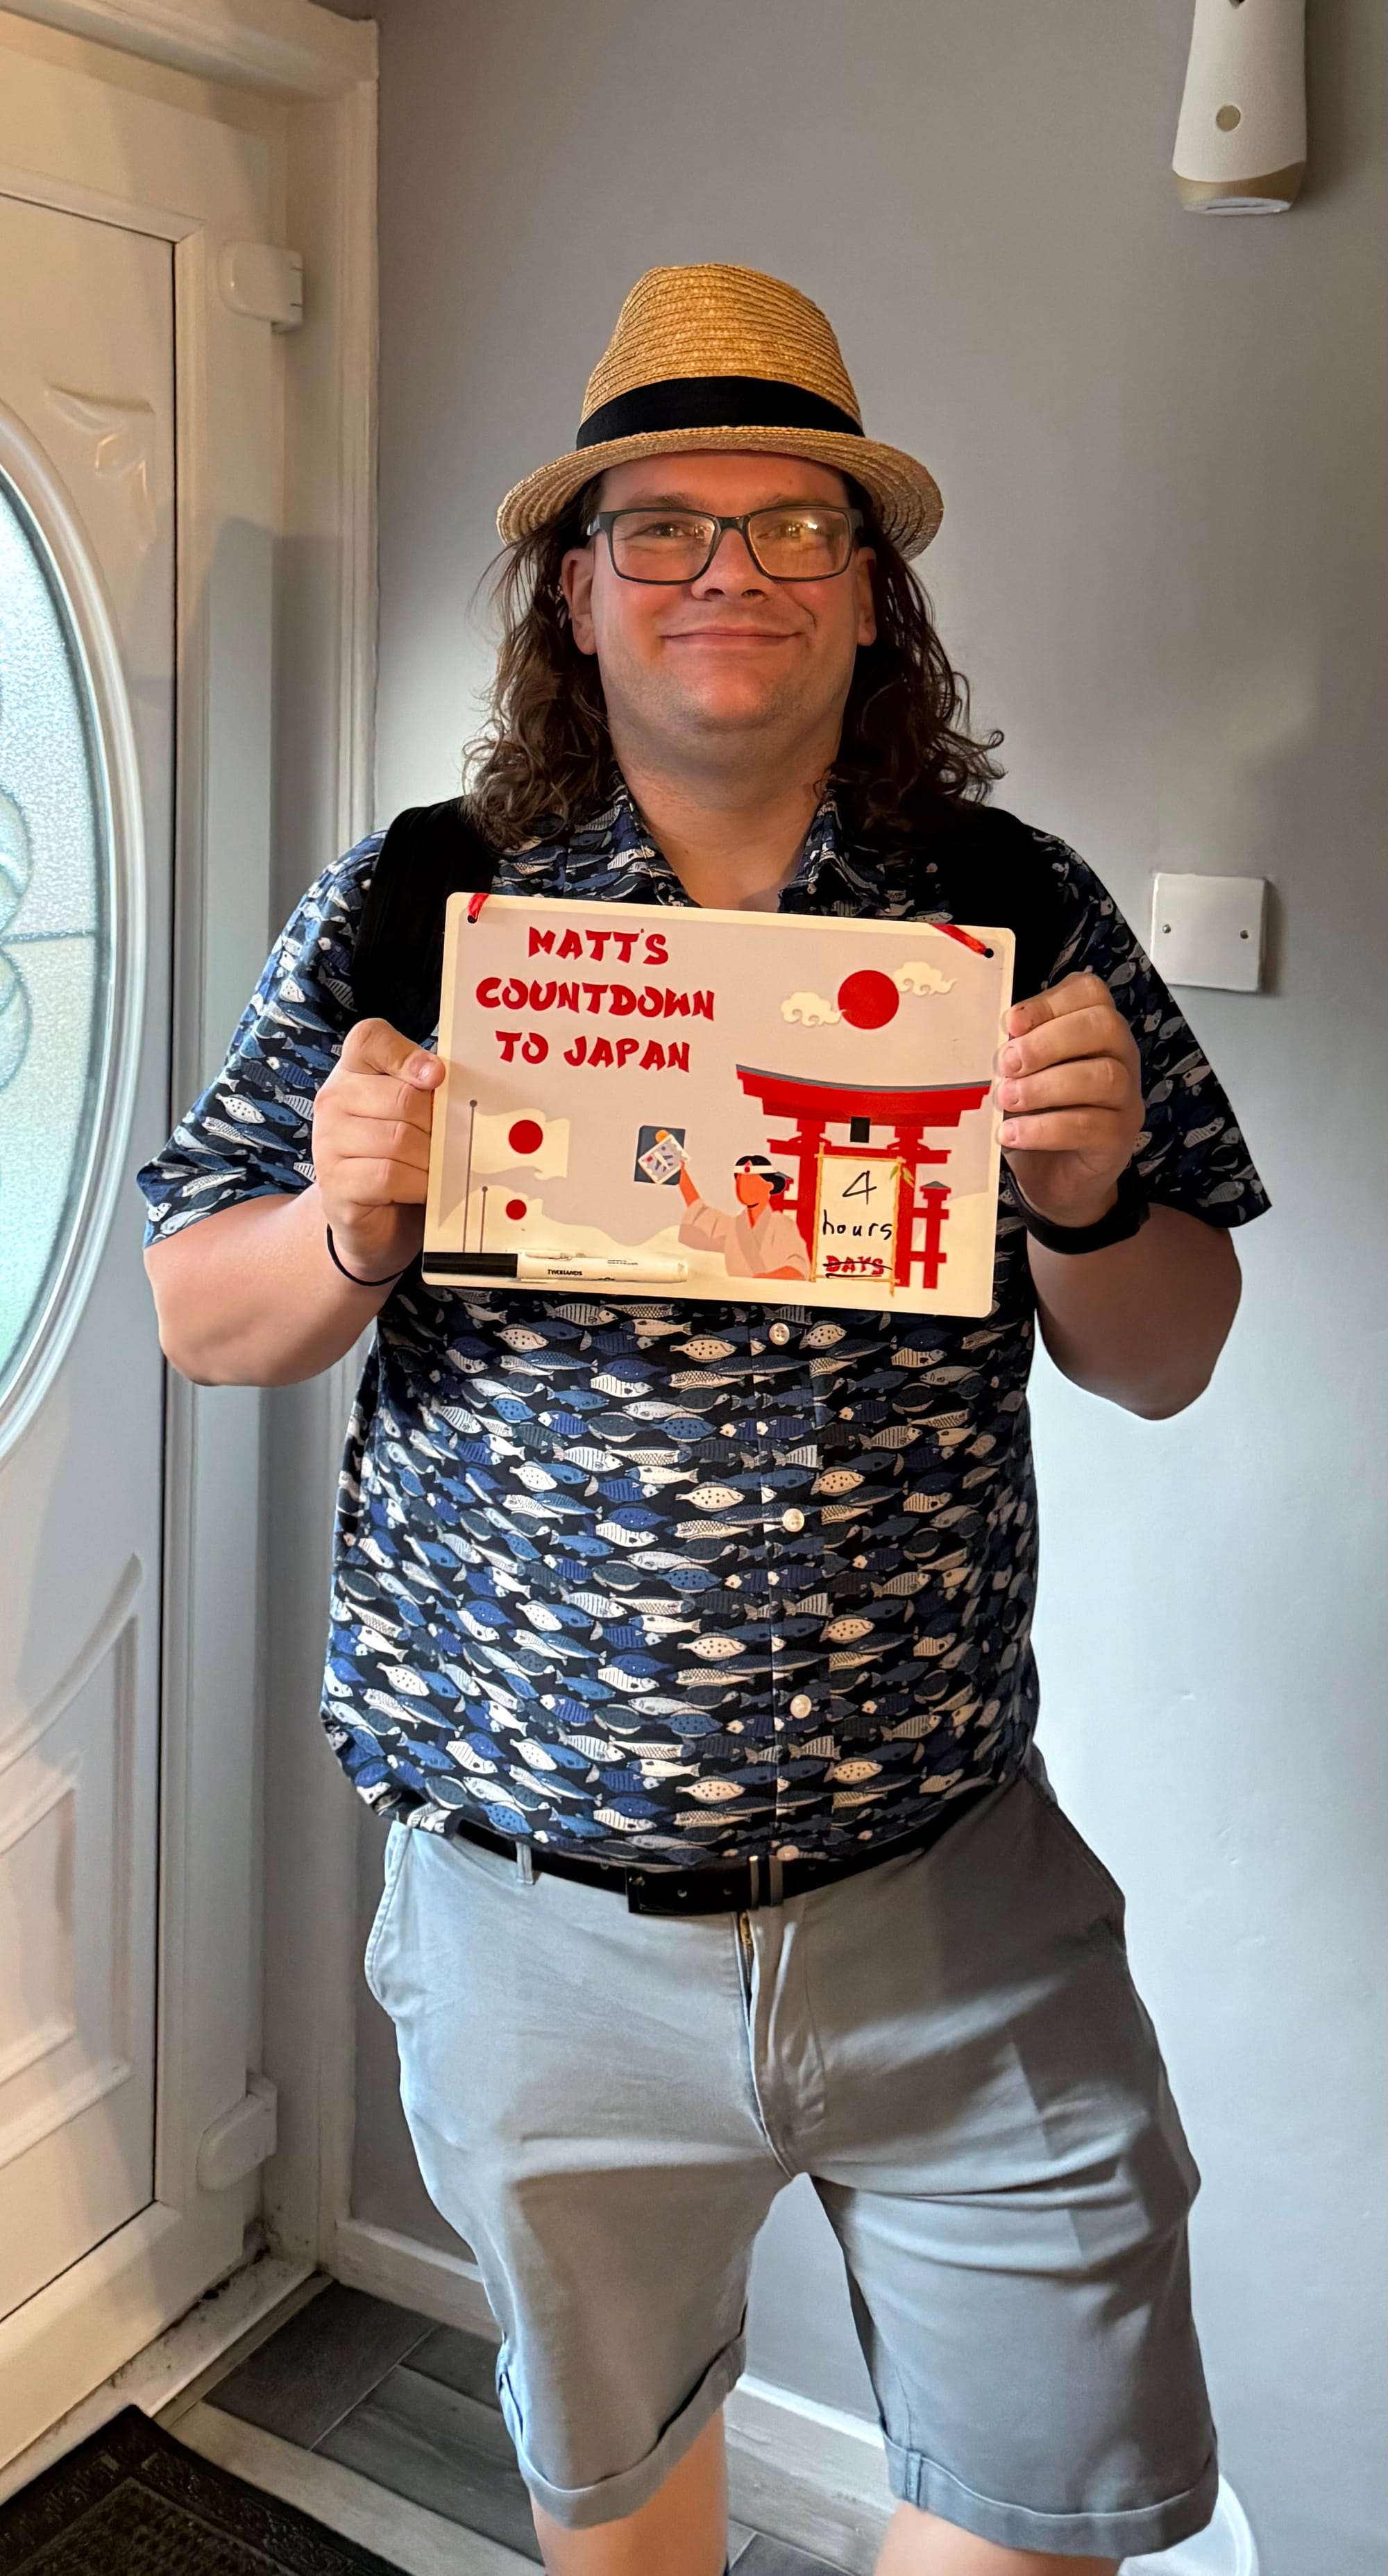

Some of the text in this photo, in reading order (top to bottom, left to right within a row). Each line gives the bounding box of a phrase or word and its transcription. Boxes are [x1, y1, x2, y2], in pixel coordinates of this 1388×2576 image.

[528, 927, 669, 966] MATT'S
[475, 977, 715, 1021] COUNTDOWN
[495, 1031, 691, 1072] TO JAPAN
[842, 1170, 878, 1206] 4
[822, 1209, 893, 1240] hours
[824, 1255, 885, 1276] DAYS
